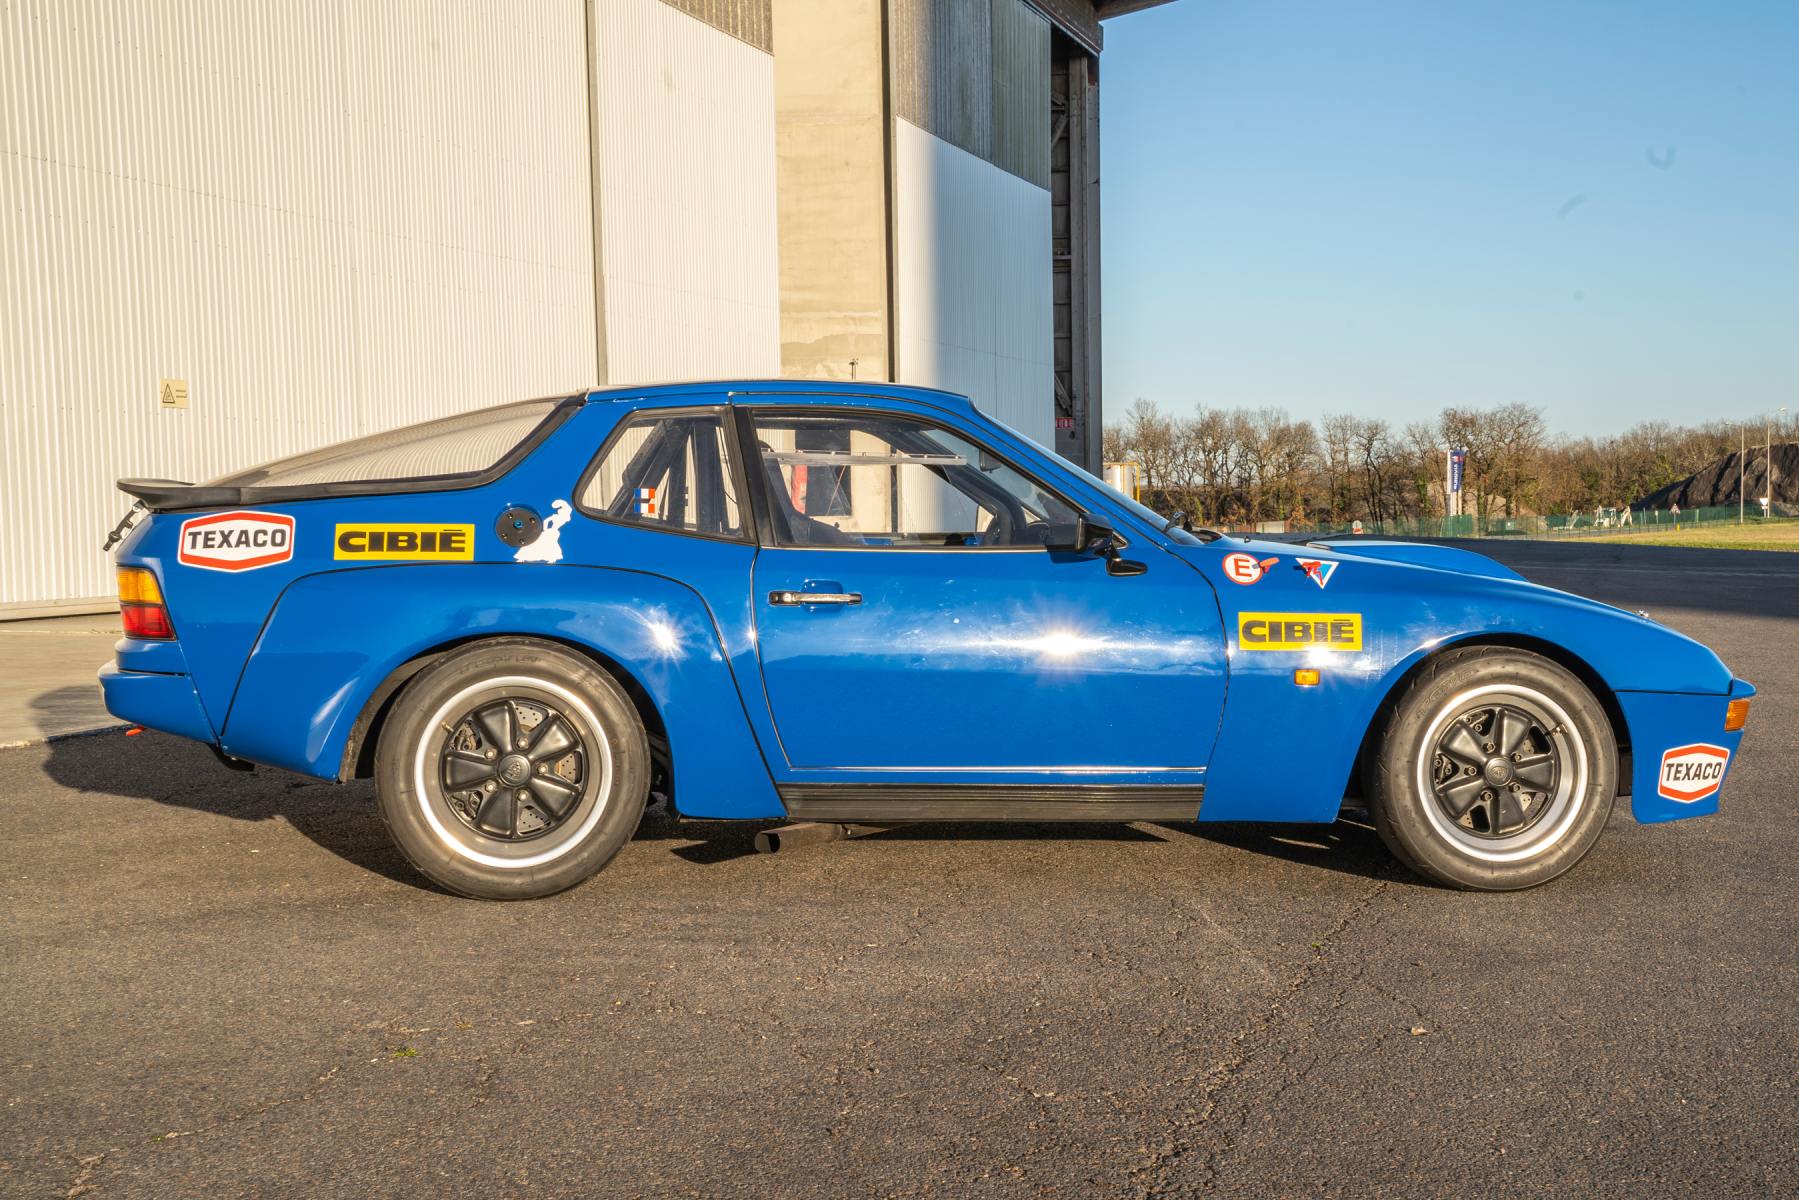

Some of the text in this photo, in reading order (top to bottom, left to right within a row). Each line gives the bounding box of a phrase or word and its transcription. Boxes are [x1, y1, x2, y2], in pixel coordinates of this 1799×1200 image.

[187, 528, 287, 550] TEXACO
[1233, 558, 1252, 578] E
[1665, 761, 1722, 781] TEXACO
